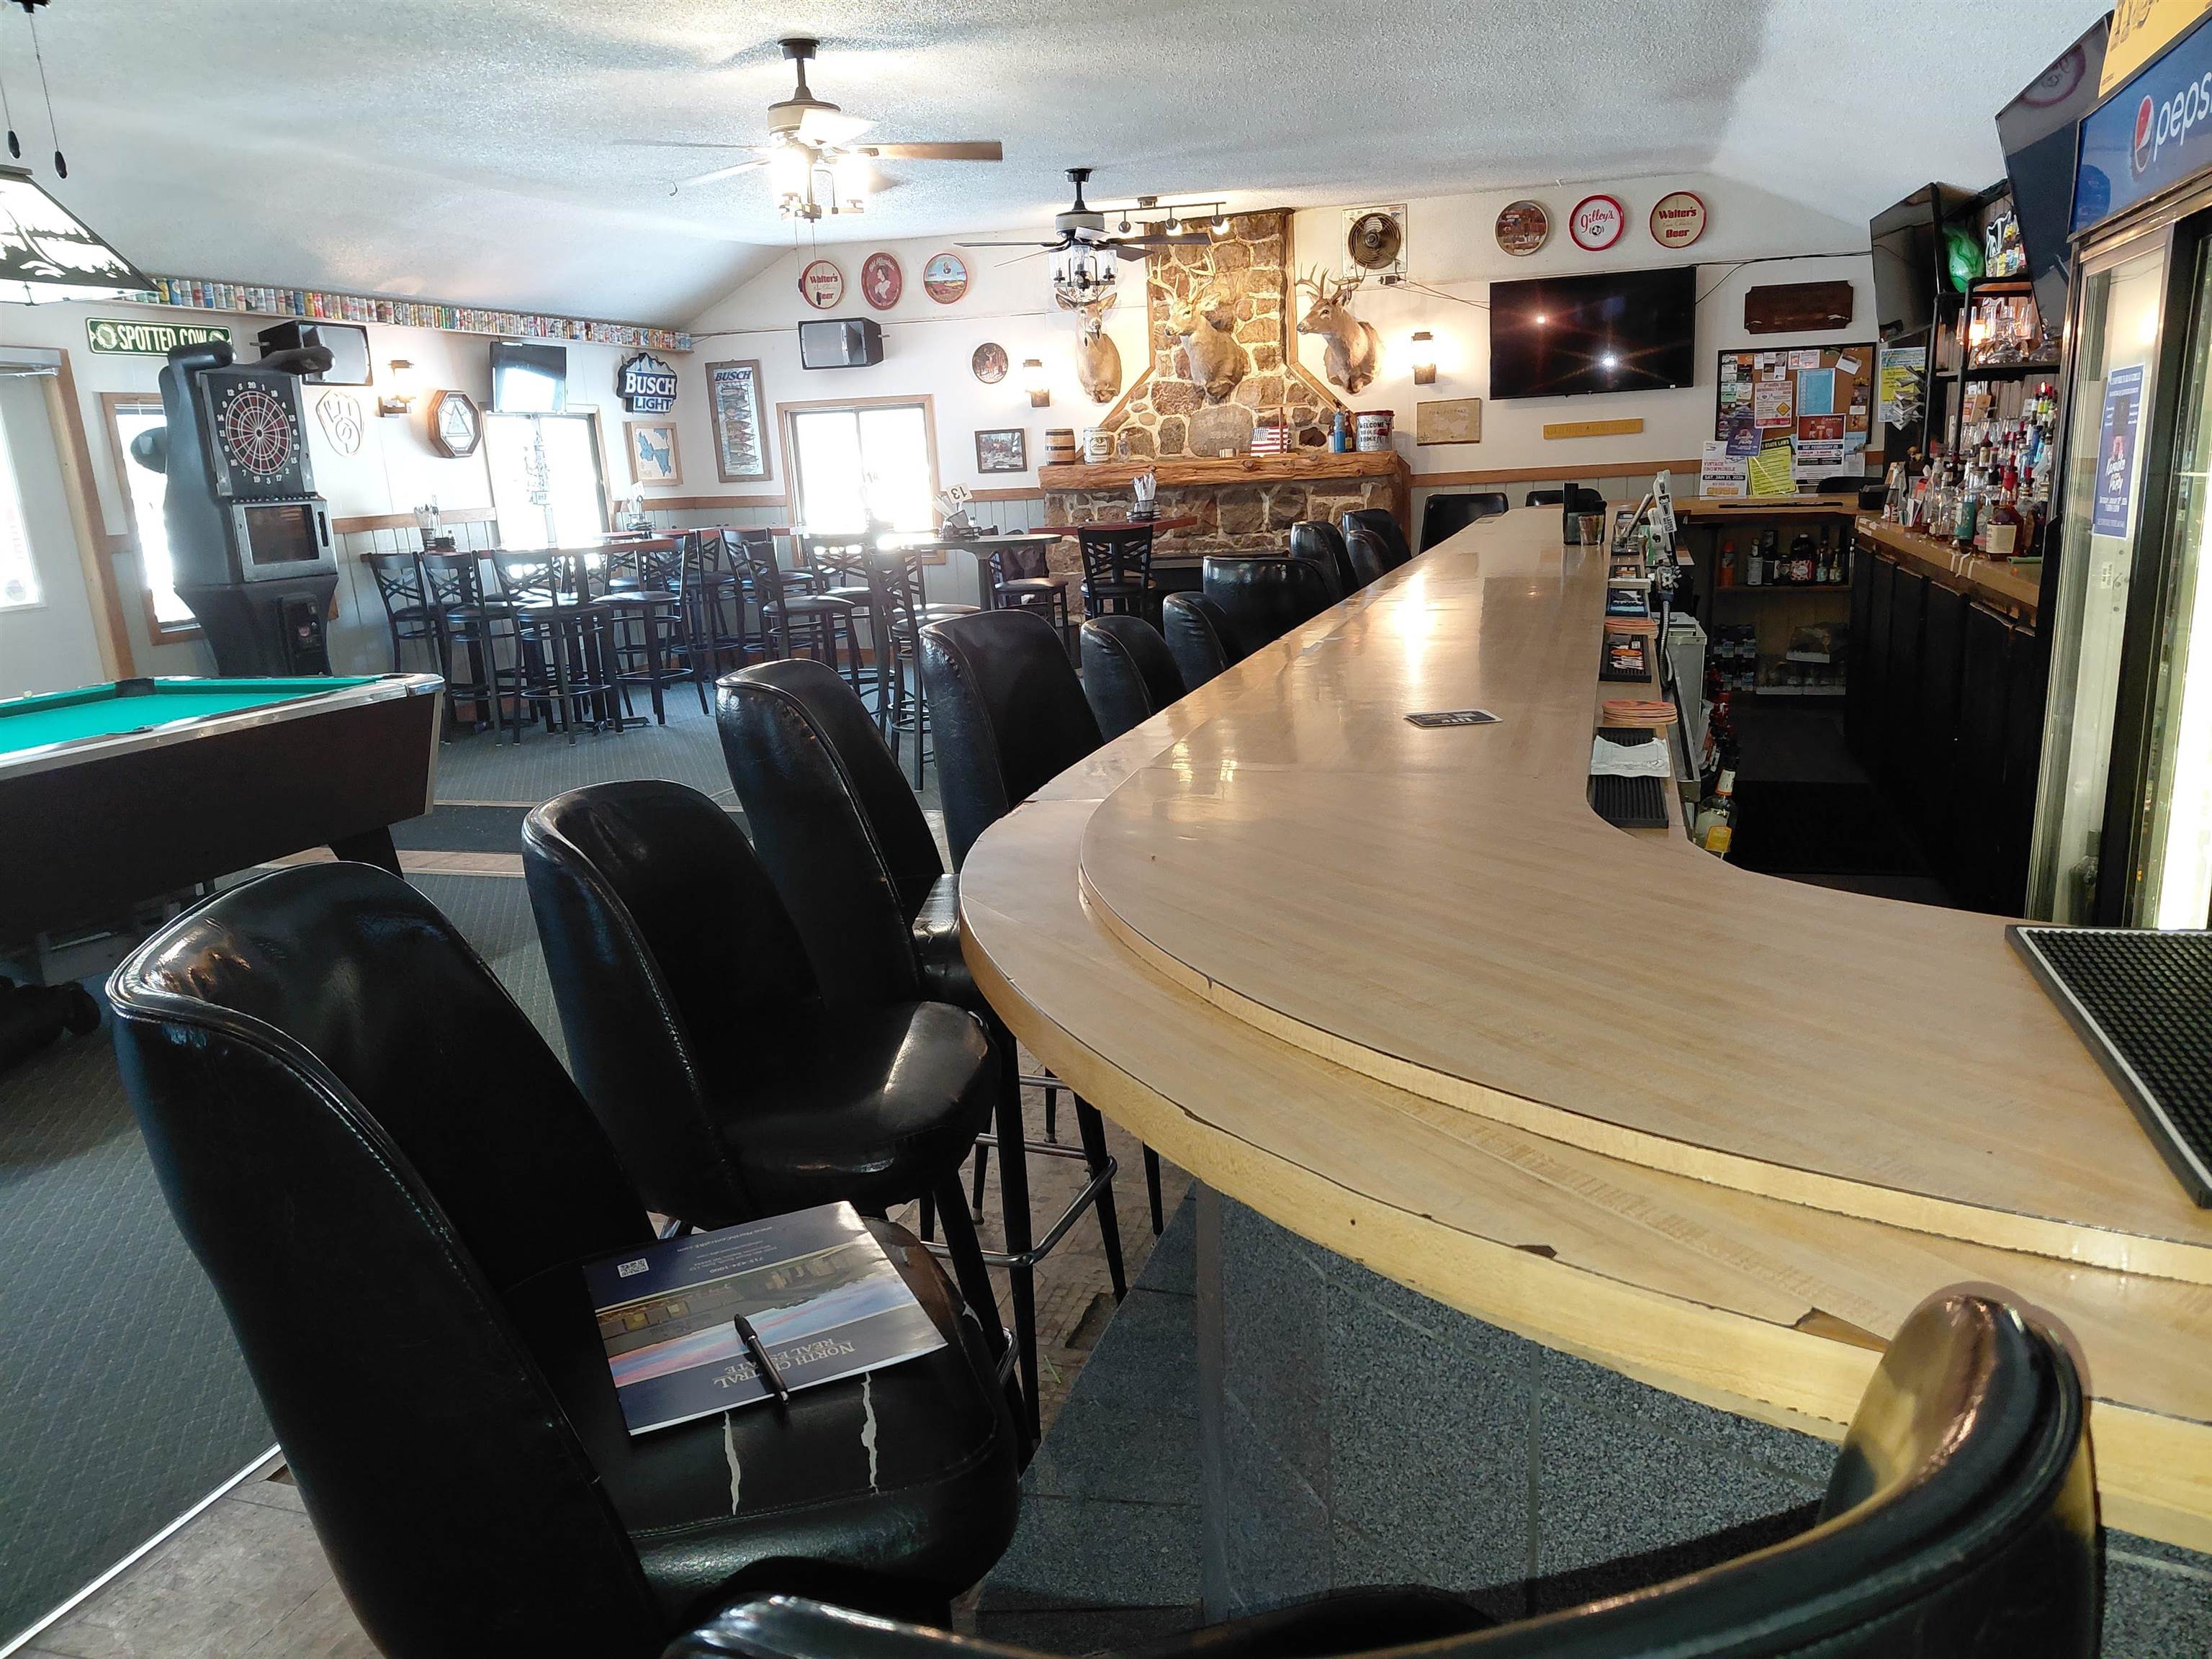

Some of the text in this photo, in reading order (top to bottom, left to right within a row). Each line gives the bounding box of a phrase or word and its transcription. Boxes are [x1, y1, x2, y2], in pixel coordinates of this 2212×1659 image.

[2153, 71, 2212, 162] peps
[1659, 206, 1697, 220] Walter's
[1665, 229, 1690, 238] Beer
[809, 273, 838, 284] Walter's
[117, 324, 178, 351] SPOTTED
[714, 370, 753, 382] BUSCH
[625, 372, 677, 396] BUSCH
[634, 398, 672, 410] LIGHT
[950, 485, 968, 500] 13
[724, 1338, 836, 1374] REAL ESATE
[714, 1341, 857, 1389] NORTH CETRAL
